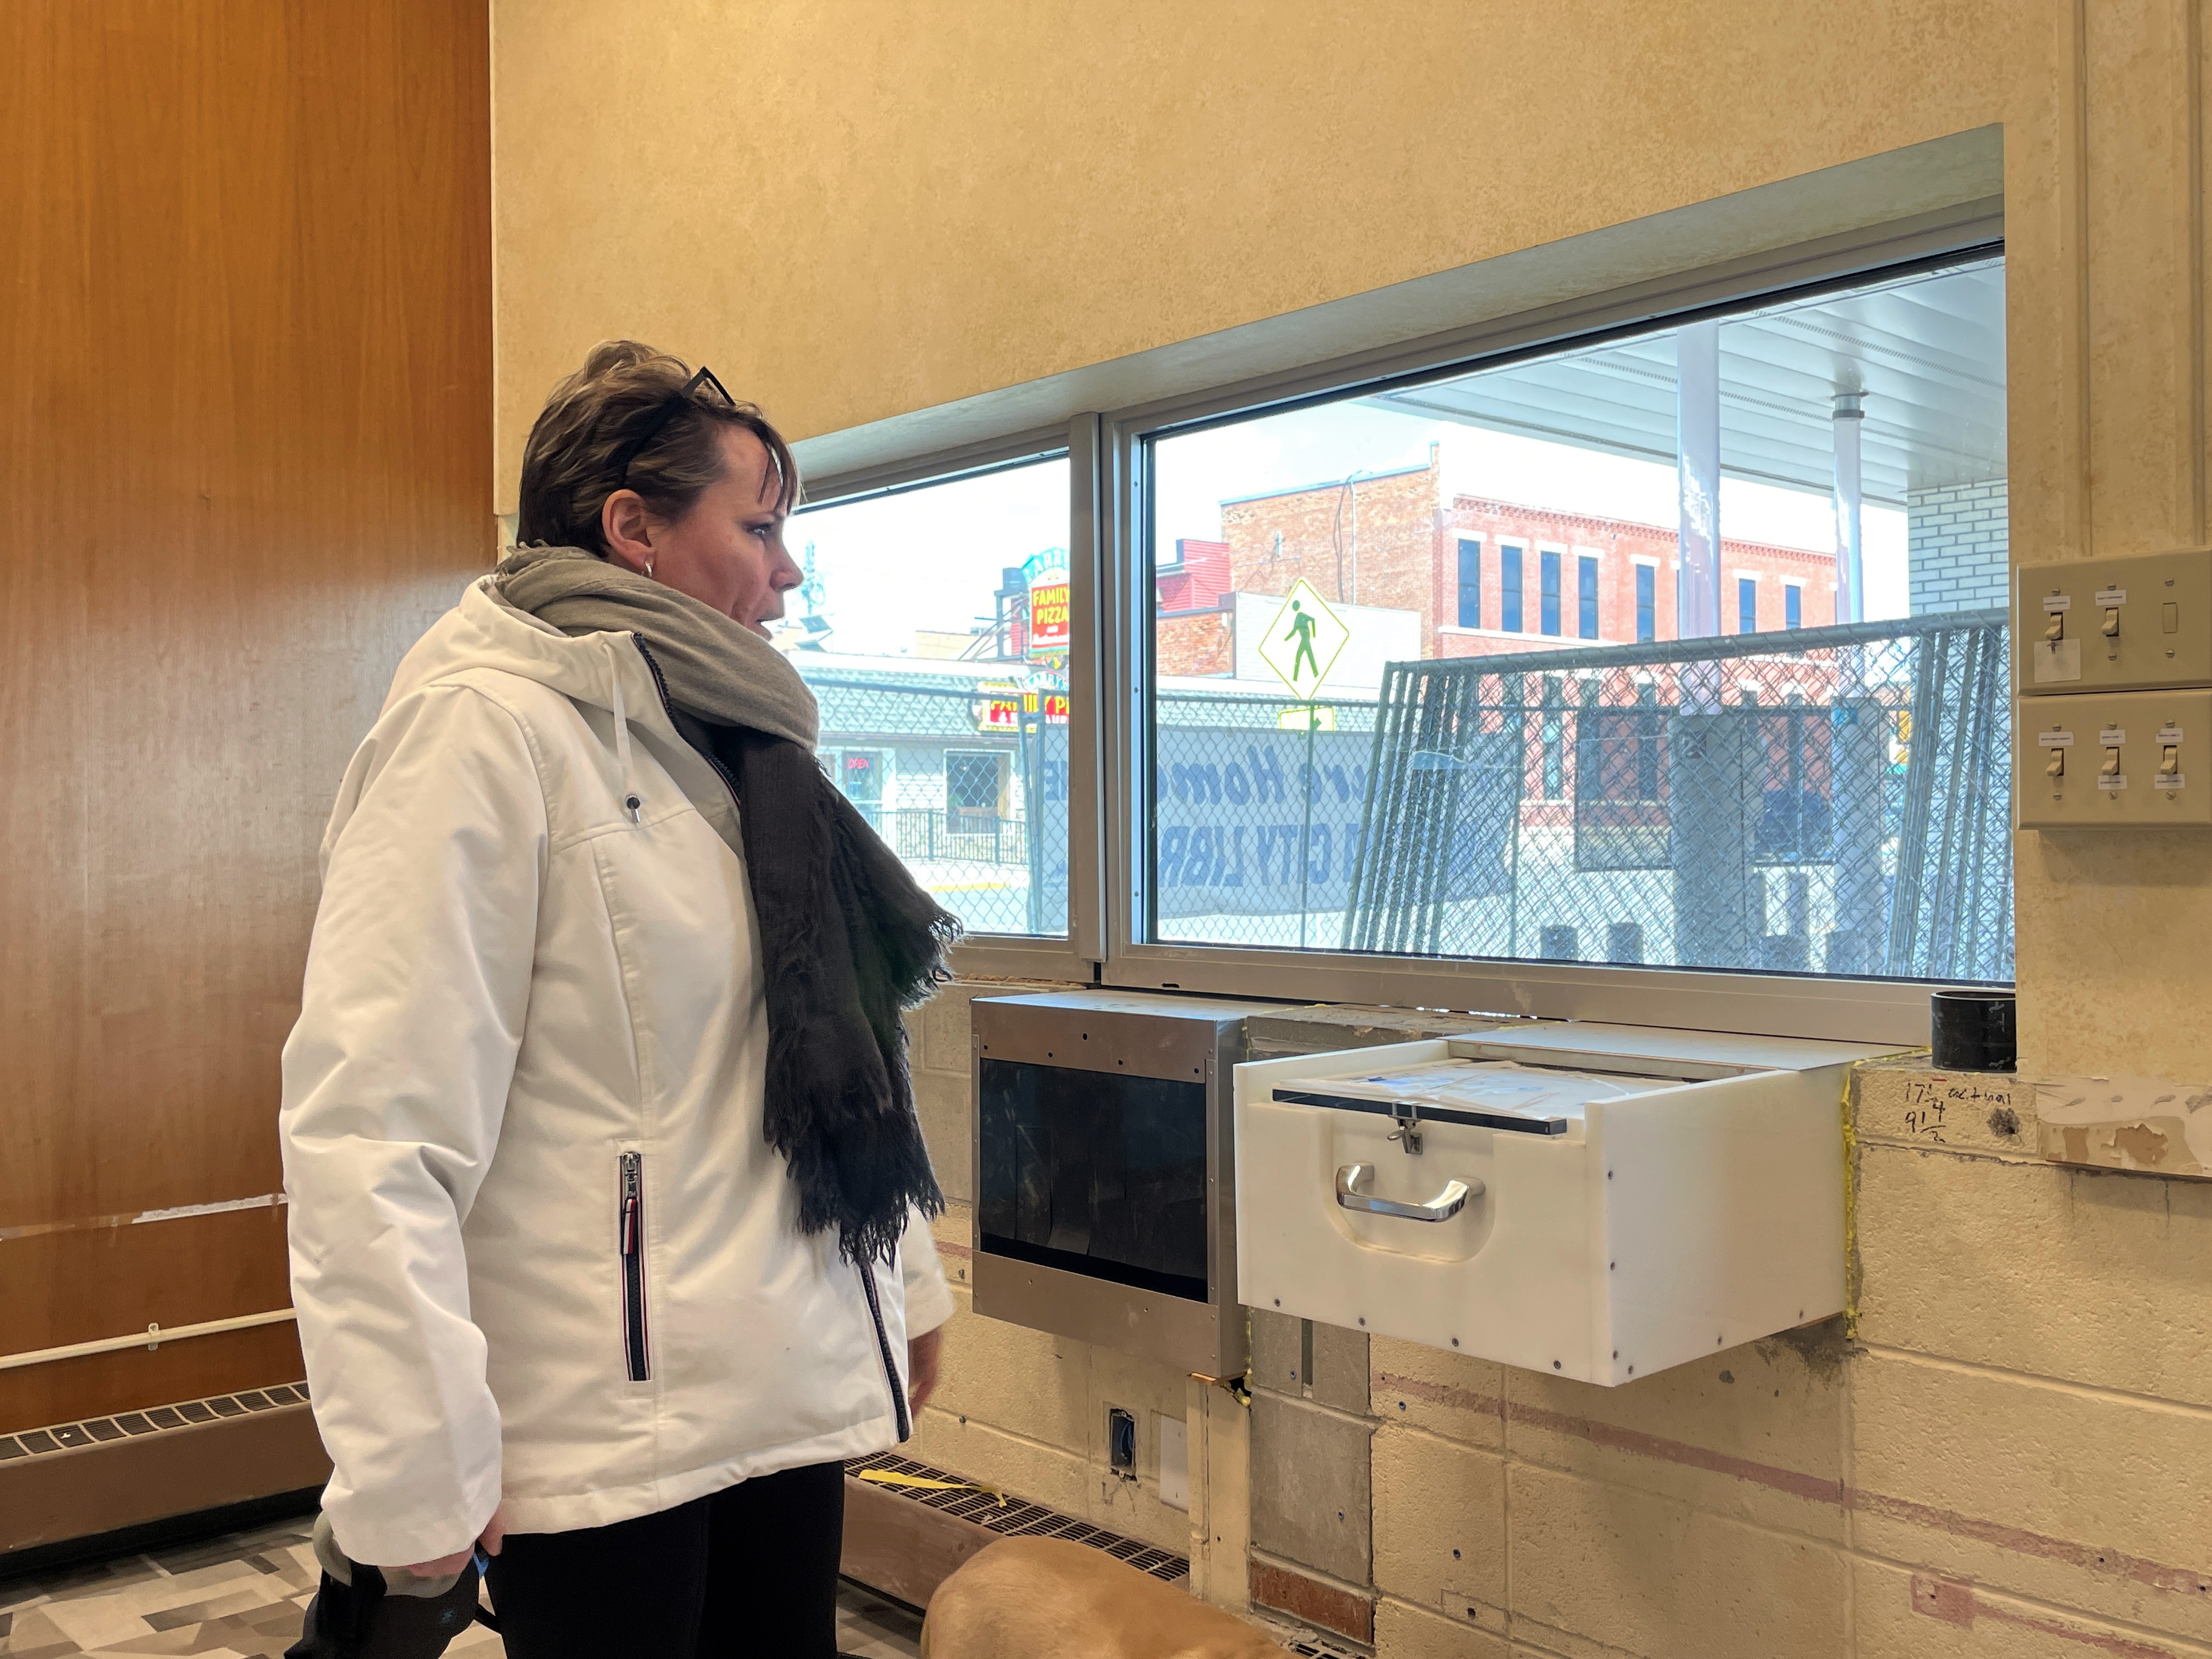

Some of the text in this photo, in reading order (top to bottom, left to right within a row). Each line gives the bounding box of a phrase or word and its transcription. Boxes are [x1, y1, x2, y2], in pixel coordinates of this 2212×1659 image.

[1032, 586, 1069, 607] FAMILY
[1036, 605, 1069, 625] PIZZA
[847, 758, 870, 769] OPEN
